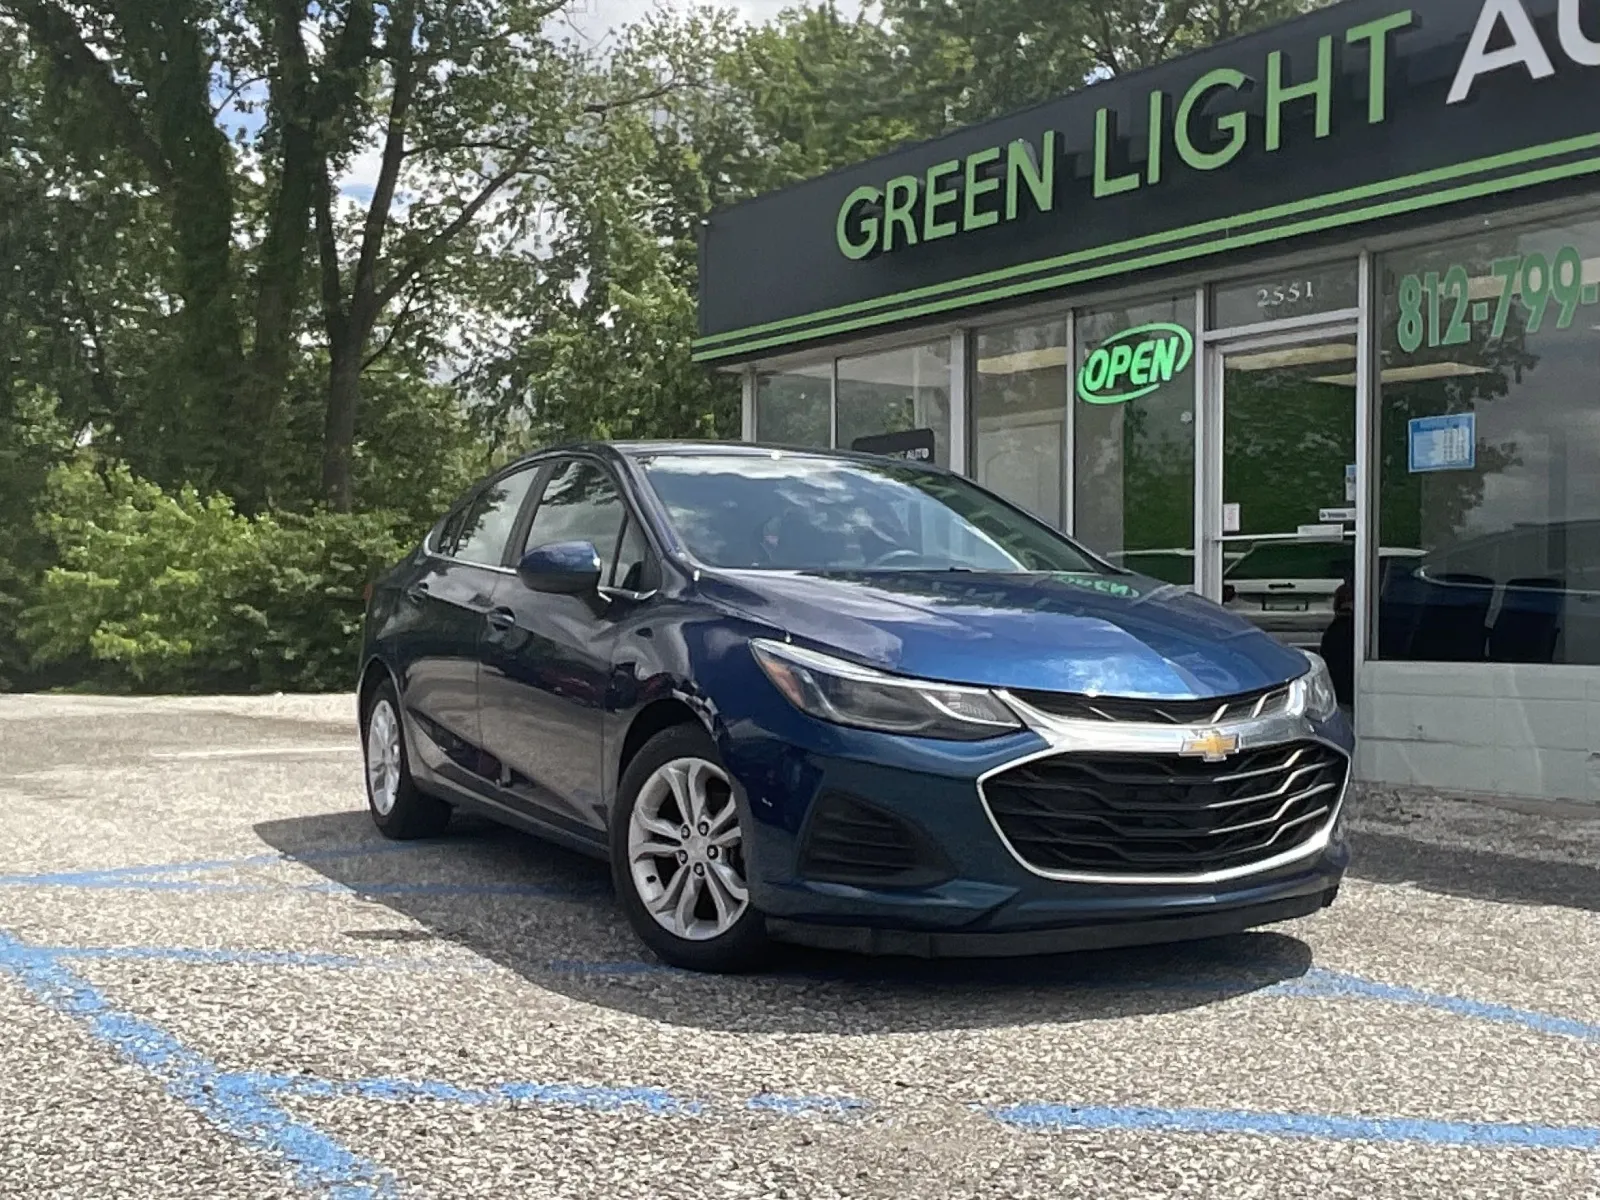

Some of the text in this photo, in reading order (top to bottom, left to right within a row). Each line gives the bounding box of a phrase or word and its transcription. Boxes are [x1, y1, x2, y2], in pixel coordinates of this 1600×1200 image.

[836, 130, 1055, 260] GREEN
[1093, 9, 1413, 198] LIGHT
[1257, 281, 1314, 307] 2551
[1397, 244, 1599, 352] 812-799-
[1084, 336, 1179, 392] OPEN
